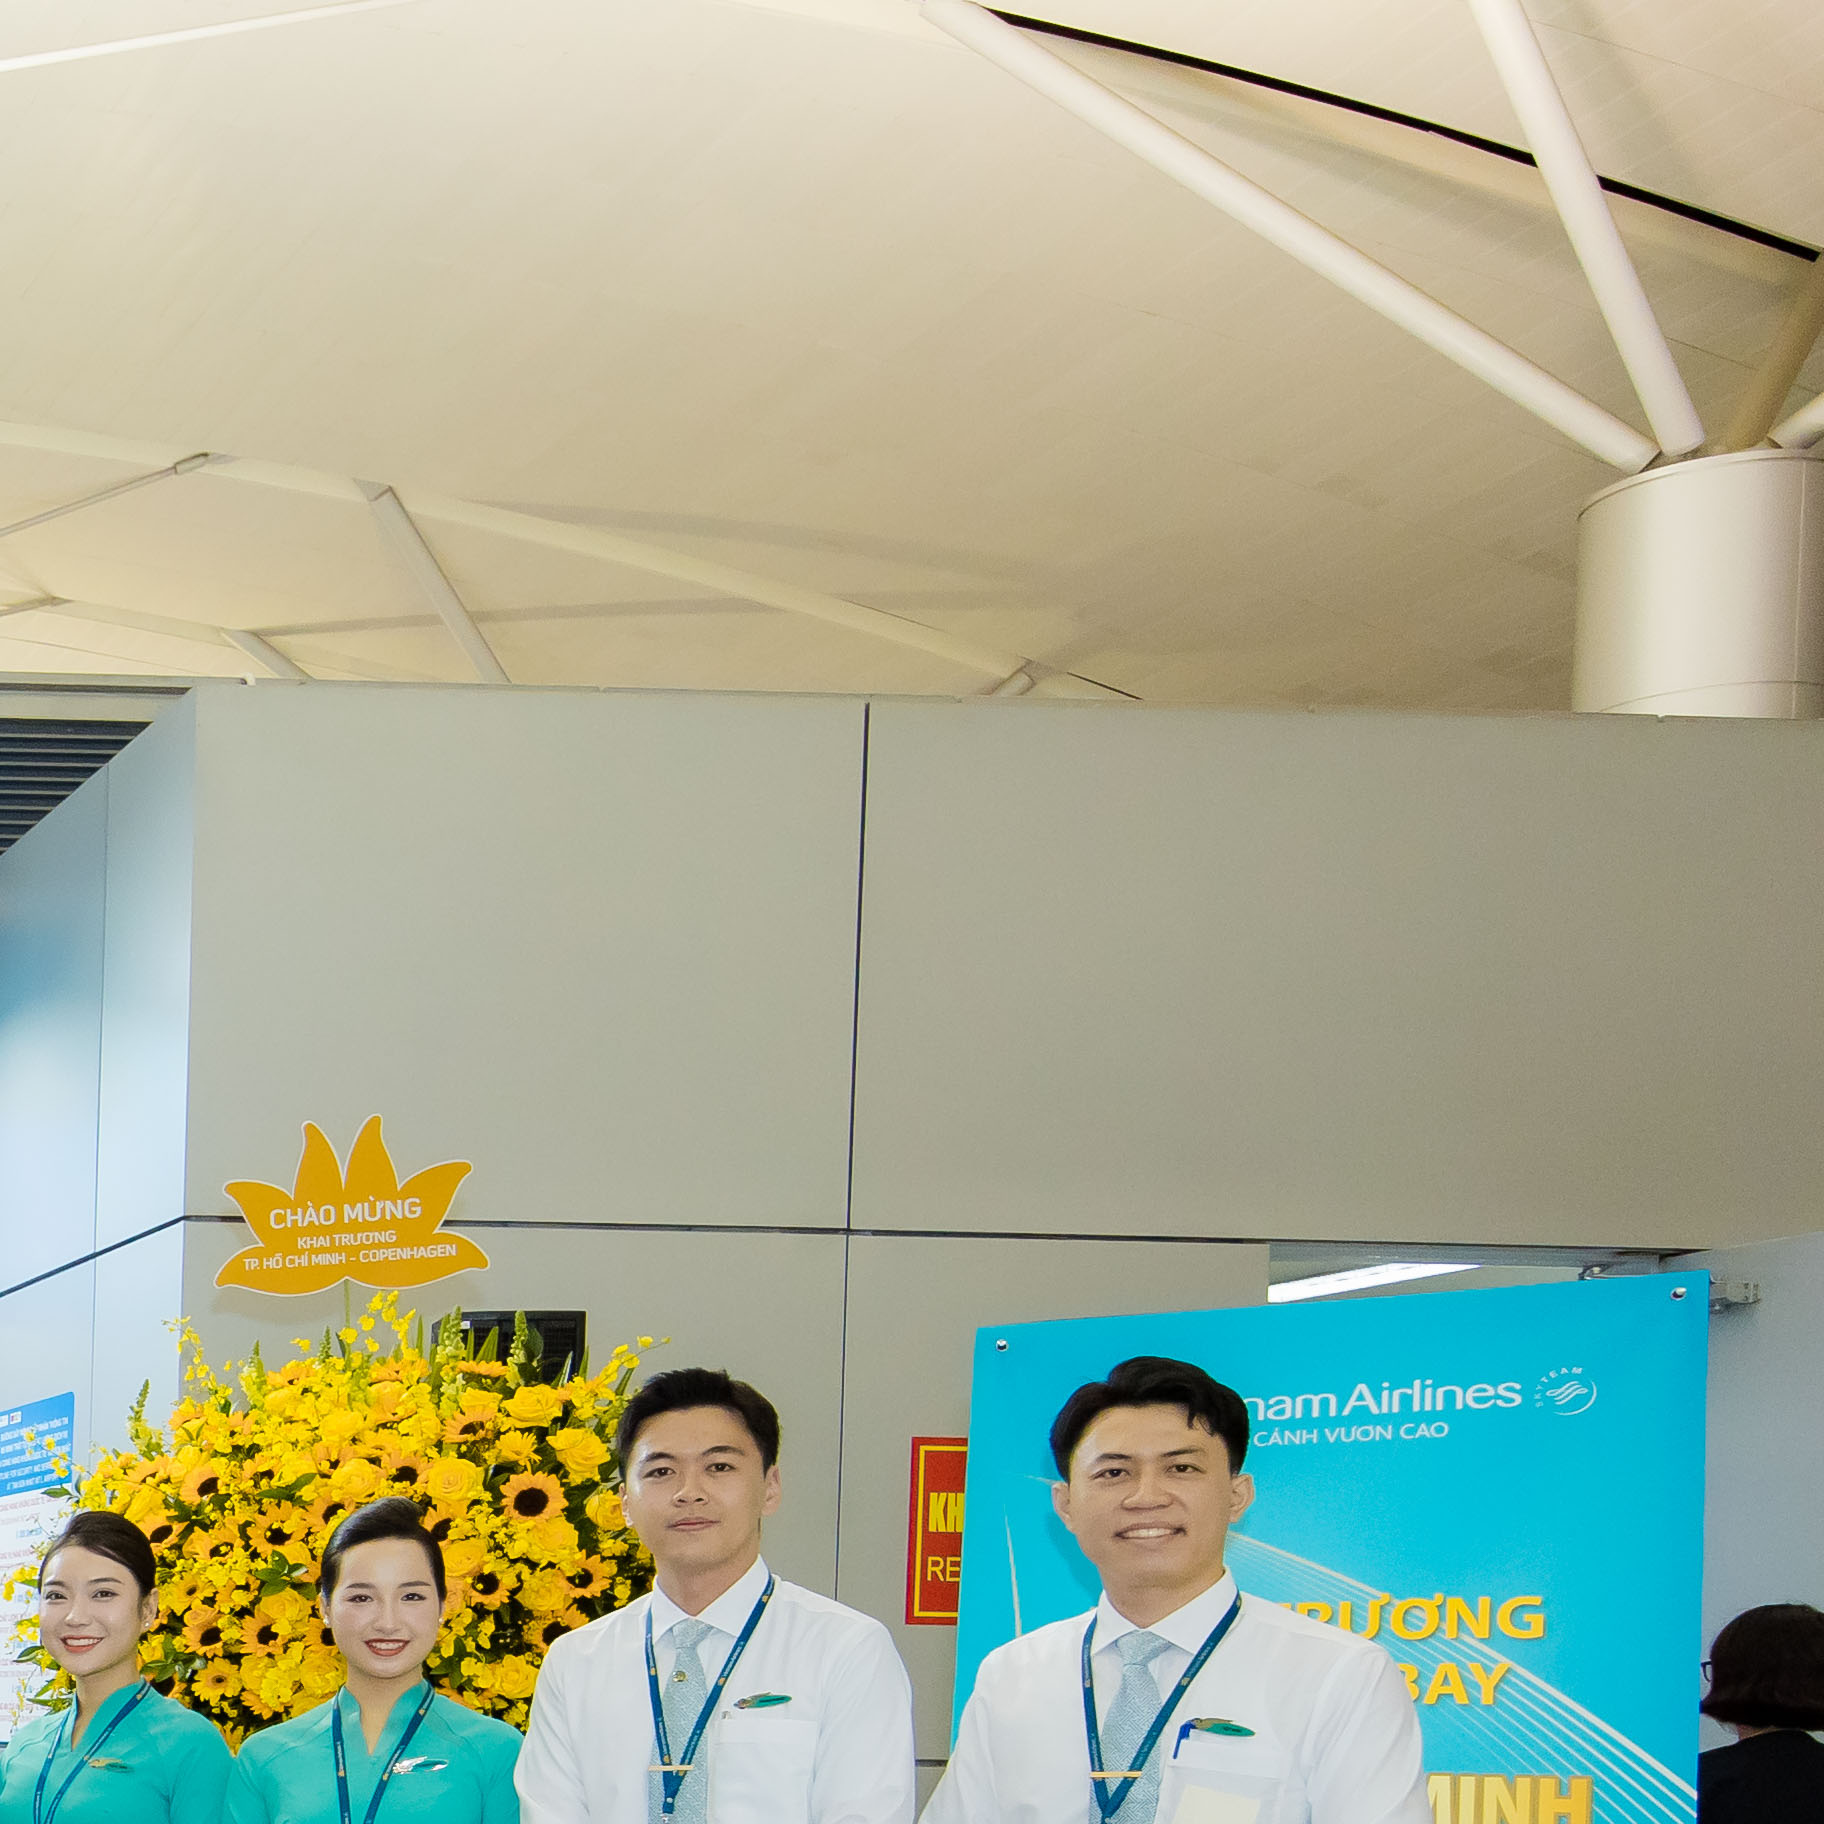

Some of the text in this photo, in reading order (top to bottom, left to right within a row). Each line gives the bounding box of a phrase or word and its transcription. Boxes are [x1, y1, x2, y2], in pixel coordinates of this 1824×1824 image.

[269, 1195, 422, 1228] CHÀO MỪNG
[297, 1229, 397, 1250] KHAI TRƯƠNG
[243, 1258, 261, 1271] TP.
[311, 1252, 346, 1267] MINH
[359, 1244, 457, 1263] COPENHAGEN
[1342, 1379, 1522, 1417] Airlines
[1253, 1422, 1449, 1447] CÁNH VƯƠN CAO
[1279, 1593, 1545, 1640] ƯƠNG
